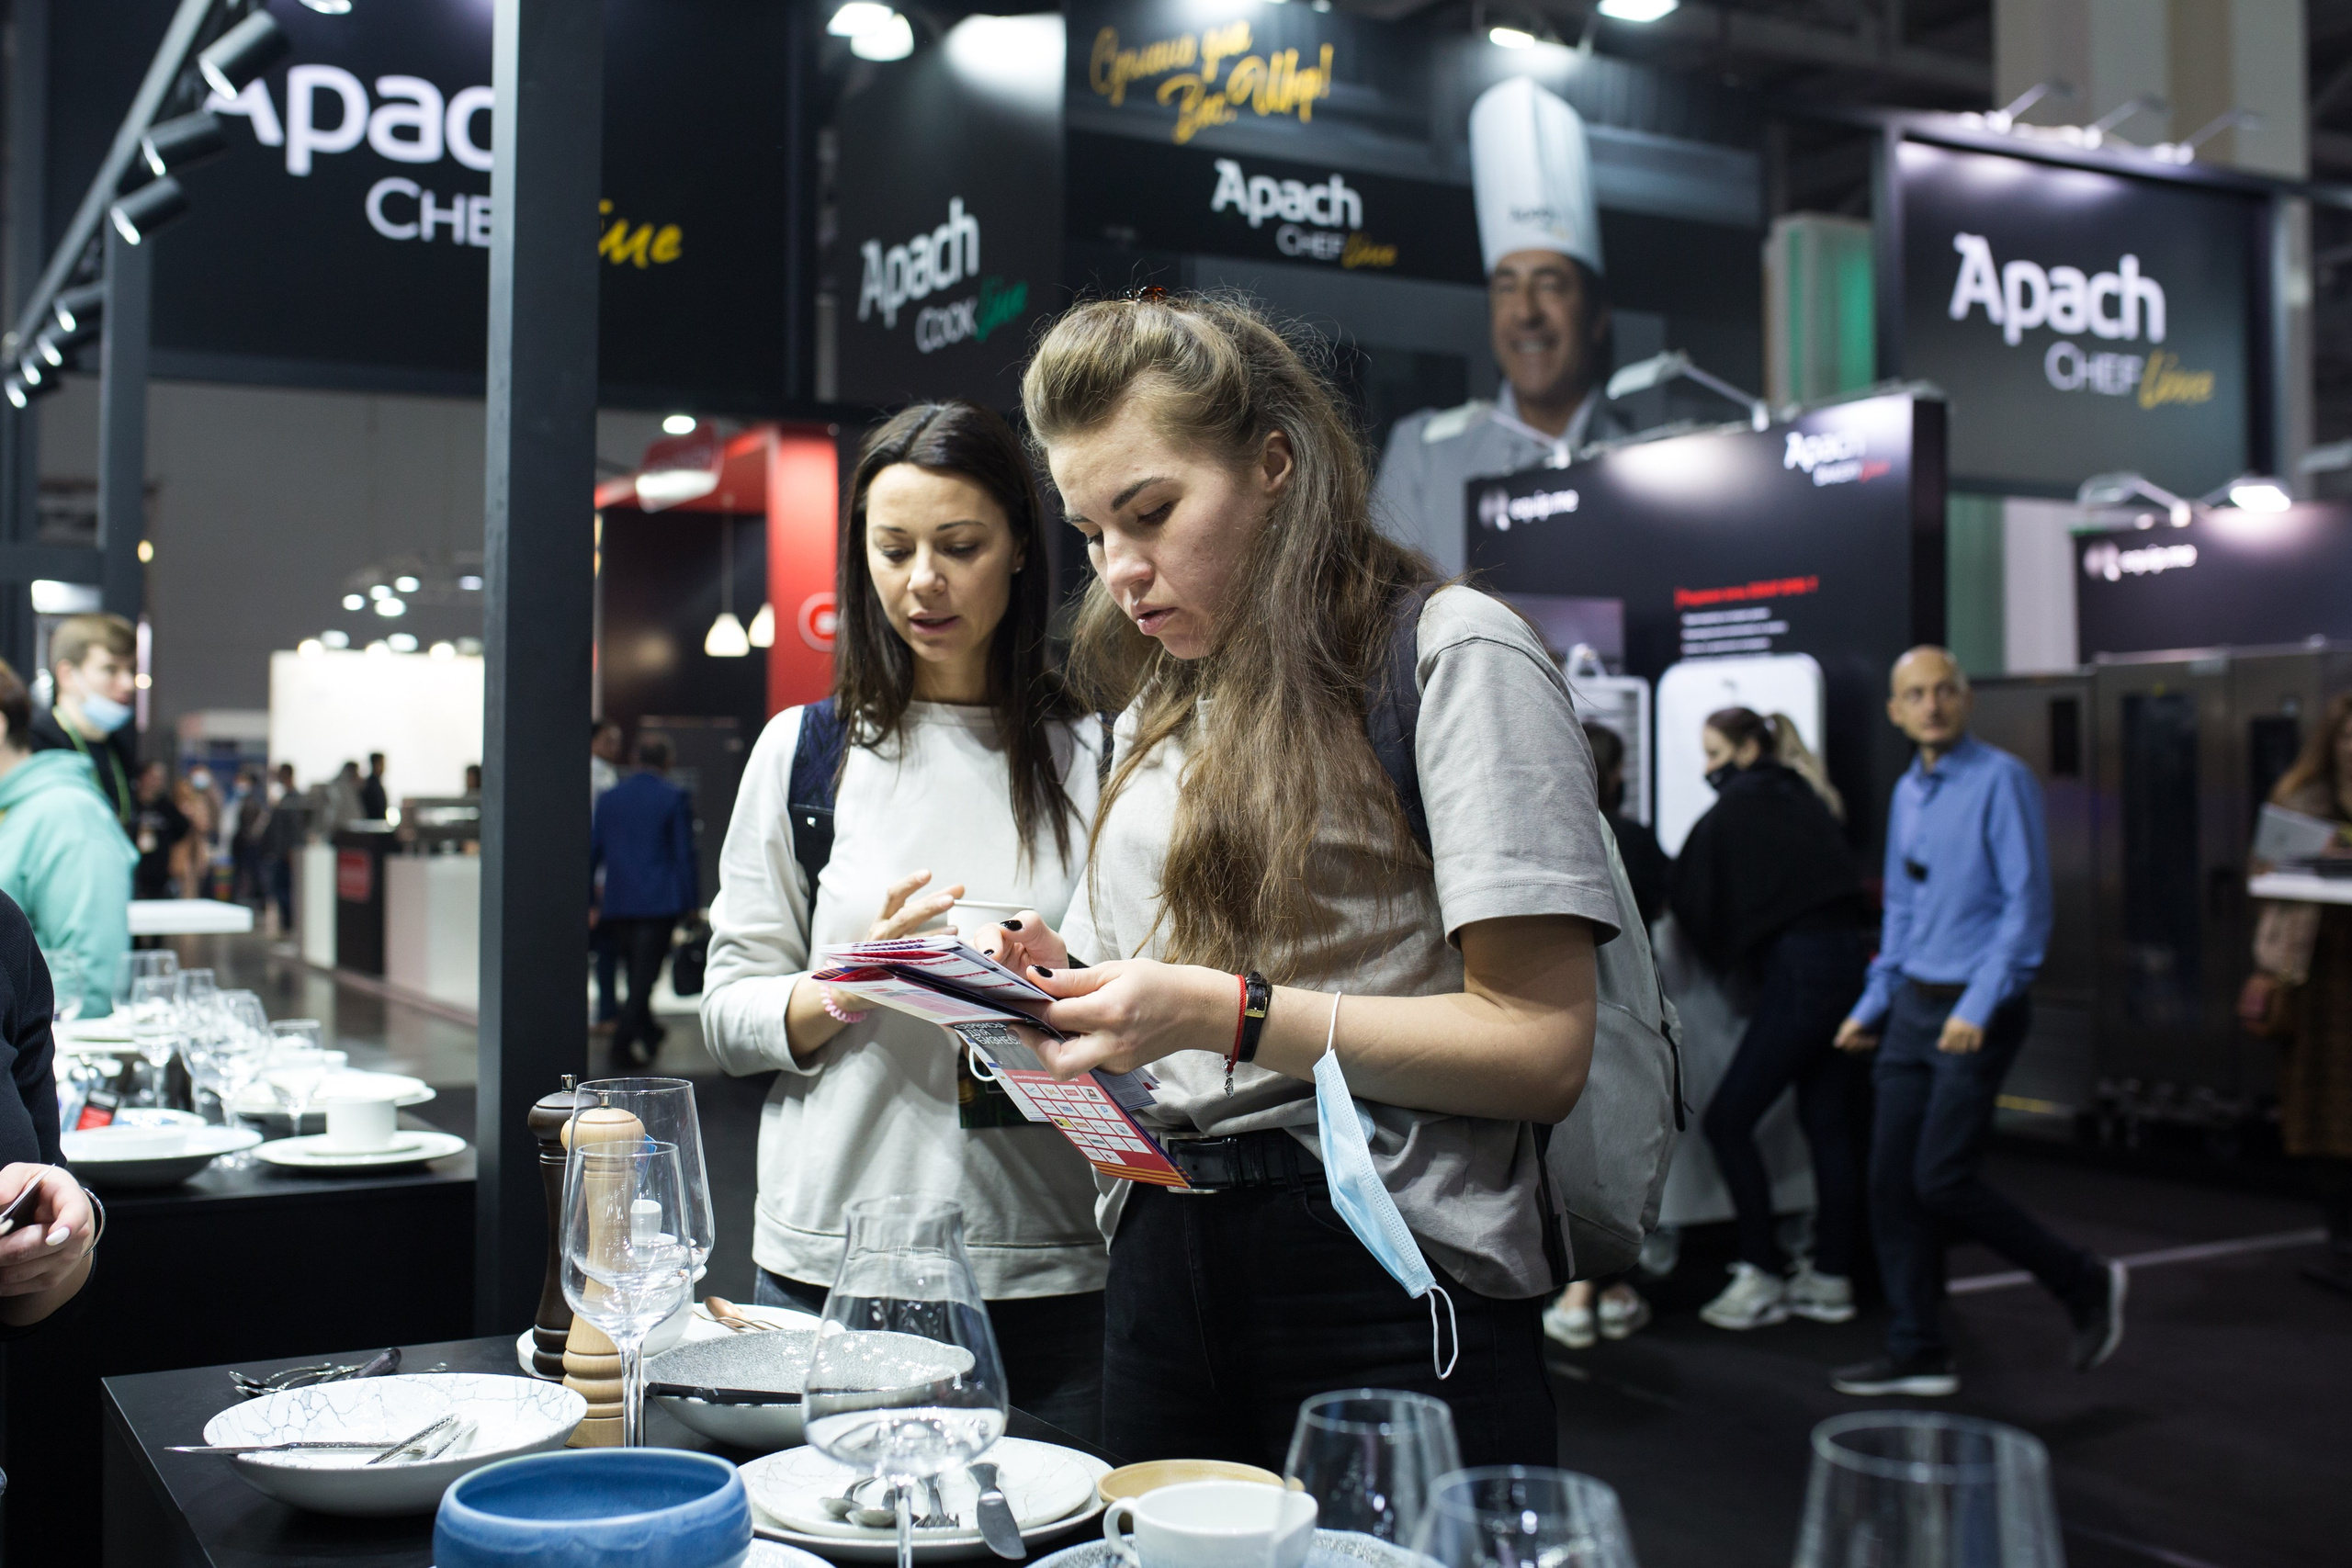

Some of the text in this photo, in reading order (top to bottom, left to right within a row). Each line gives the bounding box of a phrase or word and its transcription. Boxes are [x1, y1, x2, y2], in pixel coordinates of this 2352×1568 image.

[203, 64, 493, 176] Apac
[366, 176, 682, 269] CHE ine
[1211, 158, 1363, 229] Apach
[858, 196, 979, 329] Apach
[1949, 232, 2165, 346] Apach
[976, 1035, 1021, 1045] БИЗНЕС
